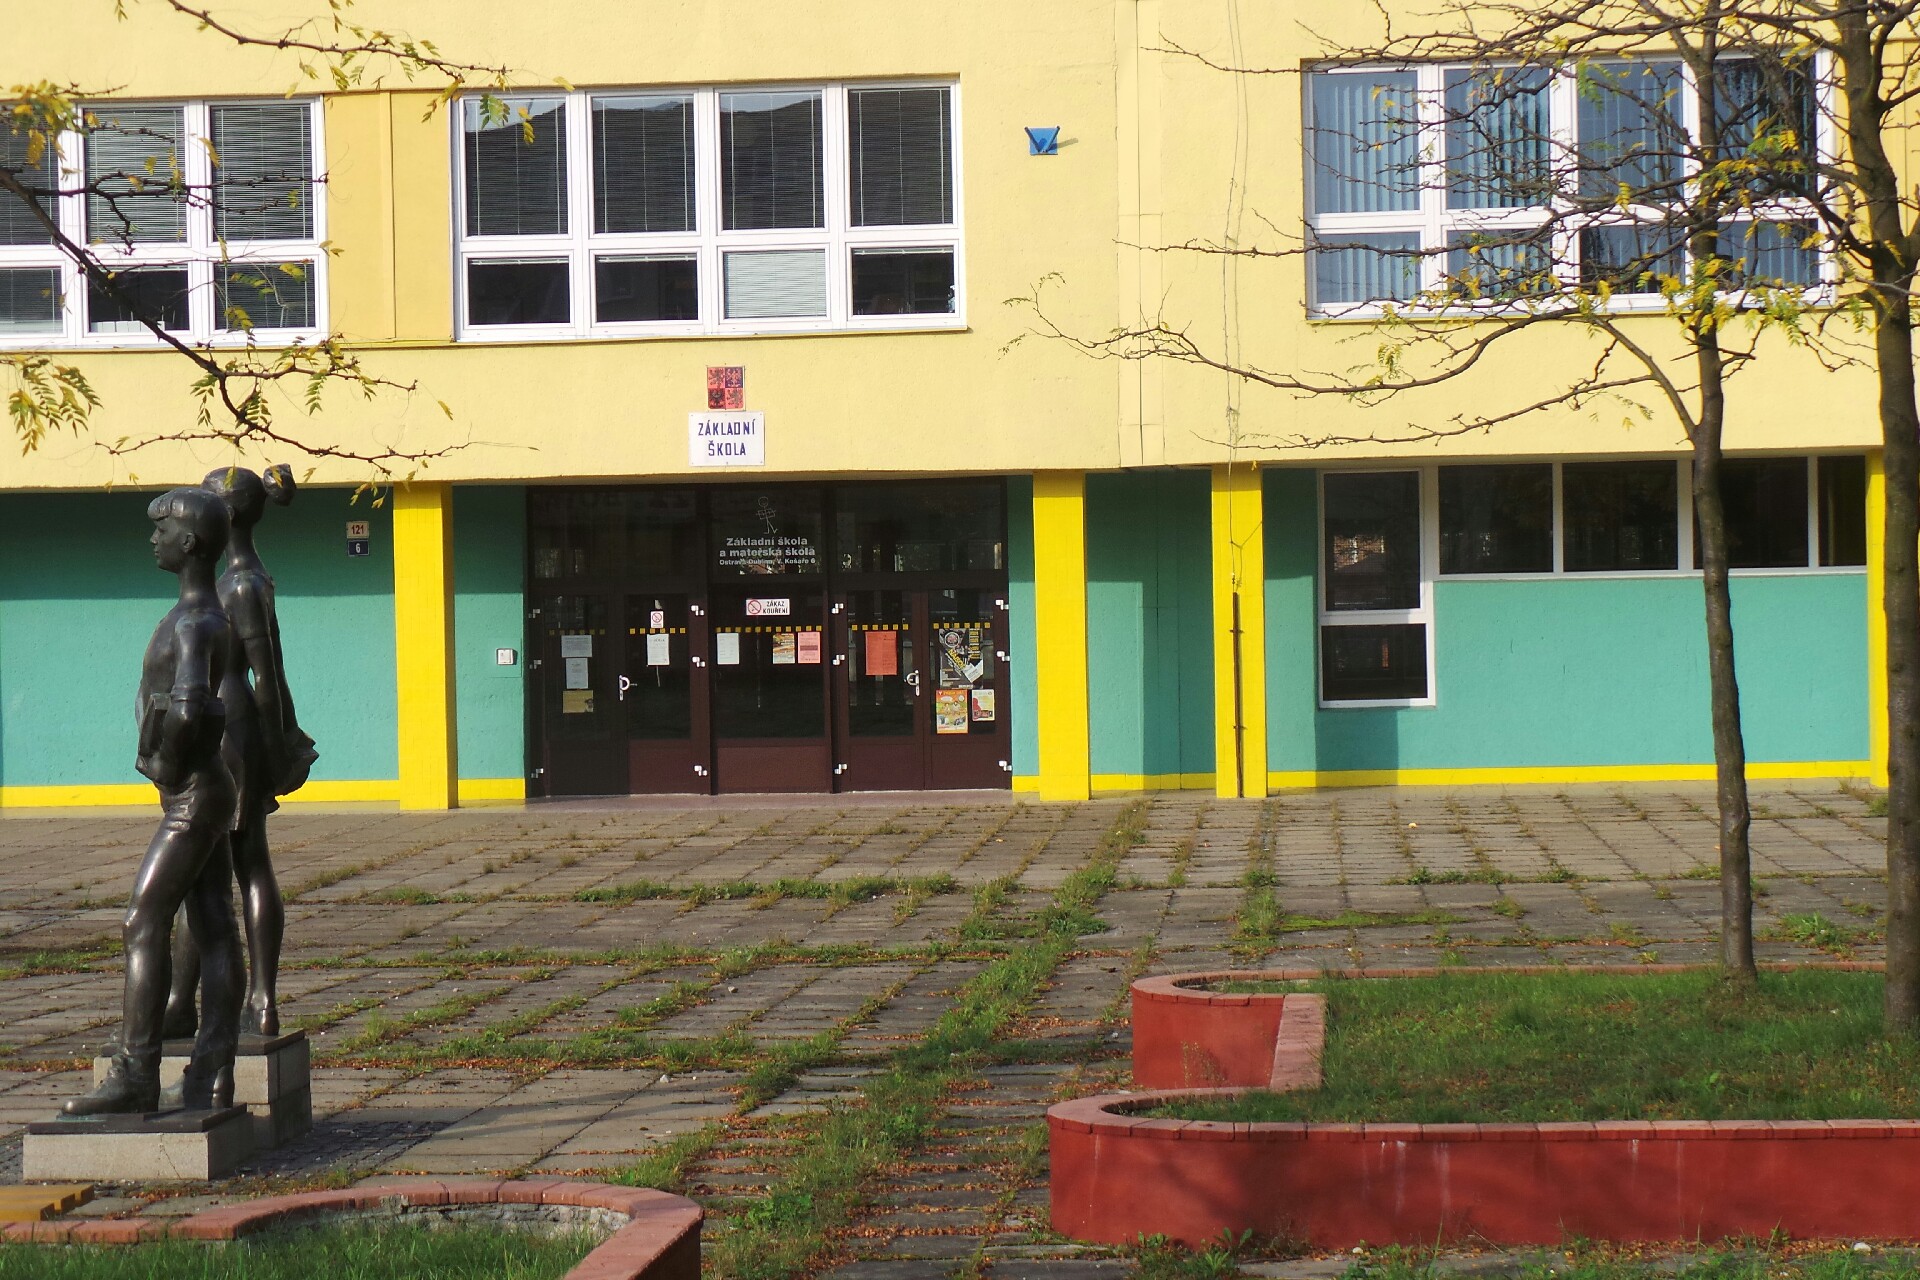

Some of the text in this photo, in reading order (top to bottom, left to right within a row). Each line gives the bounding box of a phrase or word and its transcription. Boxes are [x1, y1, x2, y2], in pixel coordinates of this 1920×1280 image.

[698, 418, 756, 436] ZÁKLADNÍ
[708, 440, 746, 456] ŠKOLA
[352, 524, 364, 535] 121
[726, 536, 808, 546] Základní škola
[355, 543, 361, 553] 6
[729, 547, 782, 557] mateřská
[785, 547, 816, 556] škola
[762, 607, 788, 615] KOUŘENÍ
